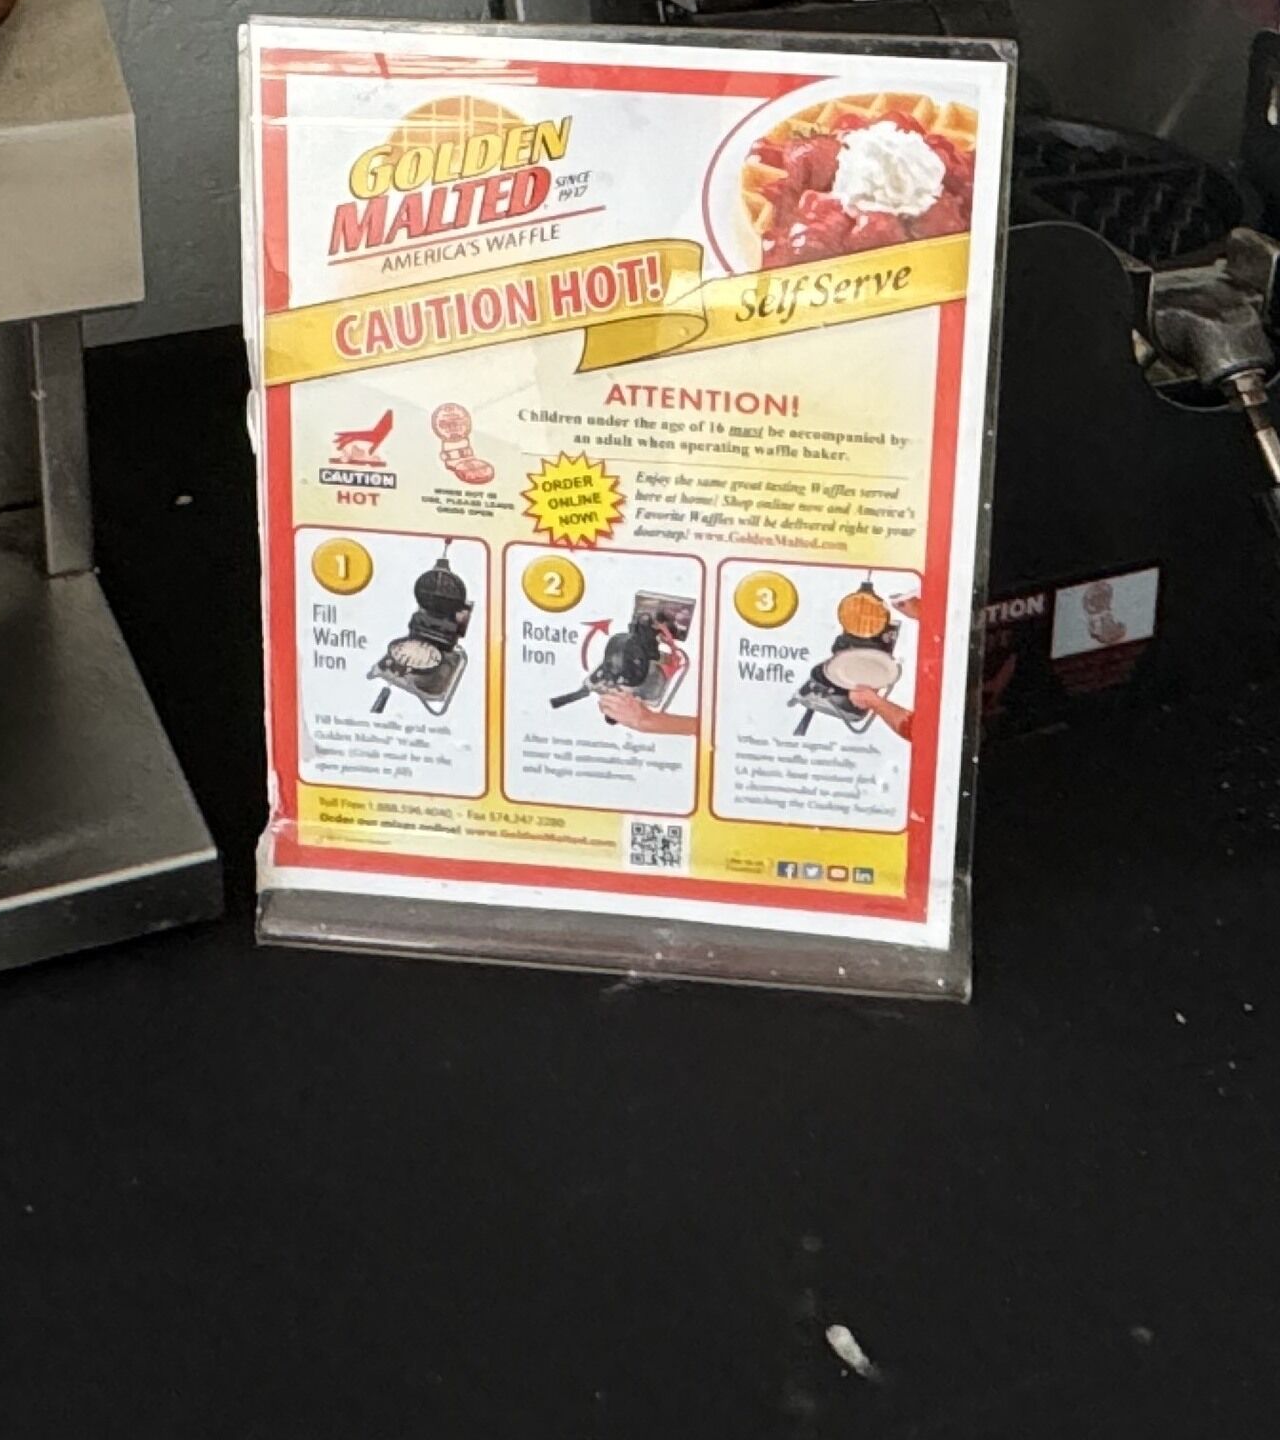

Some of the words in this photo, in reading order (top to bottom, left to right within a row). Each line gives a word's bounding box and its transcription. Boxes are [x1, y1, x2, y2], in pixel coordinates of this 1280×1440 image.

[350, 115, 573, 200] GOLDEN
[328, 166, 552, 256] MALTED
[381, 241, 481, 274] AMERICA'S
[486, 223, 561, 254] WAFFLE
[735, 277, 805, 323] Self
[808, 261, 913, 308] Serve
[335, 276, 538, 358] CAUTION
[550, 253, 664, 318] HOT!
[604, 383, 800, 418] ATTENTION!
[518, 409, 582, 426] Children
[587, 413, 629, 428] under
[634, 415, 657, 429] the
[661, 419, 686, 434] age
[689, 418, 705, 432] of
[709, 421, 725, 434] 16
[728, 424, 763, 439] must
[768, 426, 785, 438] be
[789, 428, 886, 447] accompanied
[890, 434, 910, 450] by
[573, 434, 591, 444] an
[595, 433, 632, 448] adult
[637, 436, 676, 450] when
[680, 440, 750, 457] operating
[754, 445, 798, 458] waffle
[803, 446, 850, 462] baker.
[321, 470, 396, 489] CAUTION
[541, 475, 593, 493] ORDER
[636, 471, 671, 487] Enjoy
[675, 473, 693, 486] the
[697, 478, 728, 488] same
[730, 480, 762, 492] great
[811, 482, 856, 500] Waffles
[860, 487, 900, 500] served
[336, 490, 381, 507] HOT
[548, 492, 601, 510] ONLINE
[635, 488, 662, 502] here
[681, 491, 719, 507] home!
[722, 494, 754, 511] Shop
[756, 498, 796, 511] online
[798, 502, 824, 513] now
[827, 502, 852, 515] and
[856, 504, 915, 520] America's
[558, 510, 599, 527] NOW!
[635, 507, 686, 522] Favorite
[690, 510, 735, 527] Waffles
[738, 514, 761, 527] will
[763, 515, 777, 528] be
[780, 517, 836, 533] delivered
[839, 520, 869, 536] right
[872, 524, 883, 535] to
[886, 526, 917, 539] your
[693, 529, 848, 552] www.GoldenMalted.com
[336, 554, 349, 579] 1
[543, 571, 564, 597] 2
[754, 587, 777, 613] 3
[313, 603, 337, 625] Fill
[313, 627, 368, 650] Waffle
[522, 622, 579, 645] Rotate
[314, 650, 347, 671] Iron
[522, 645, 556, 666] Iron
[739, 638, 810, 661] Remove
[738, 660, 795, 684] Waffle
